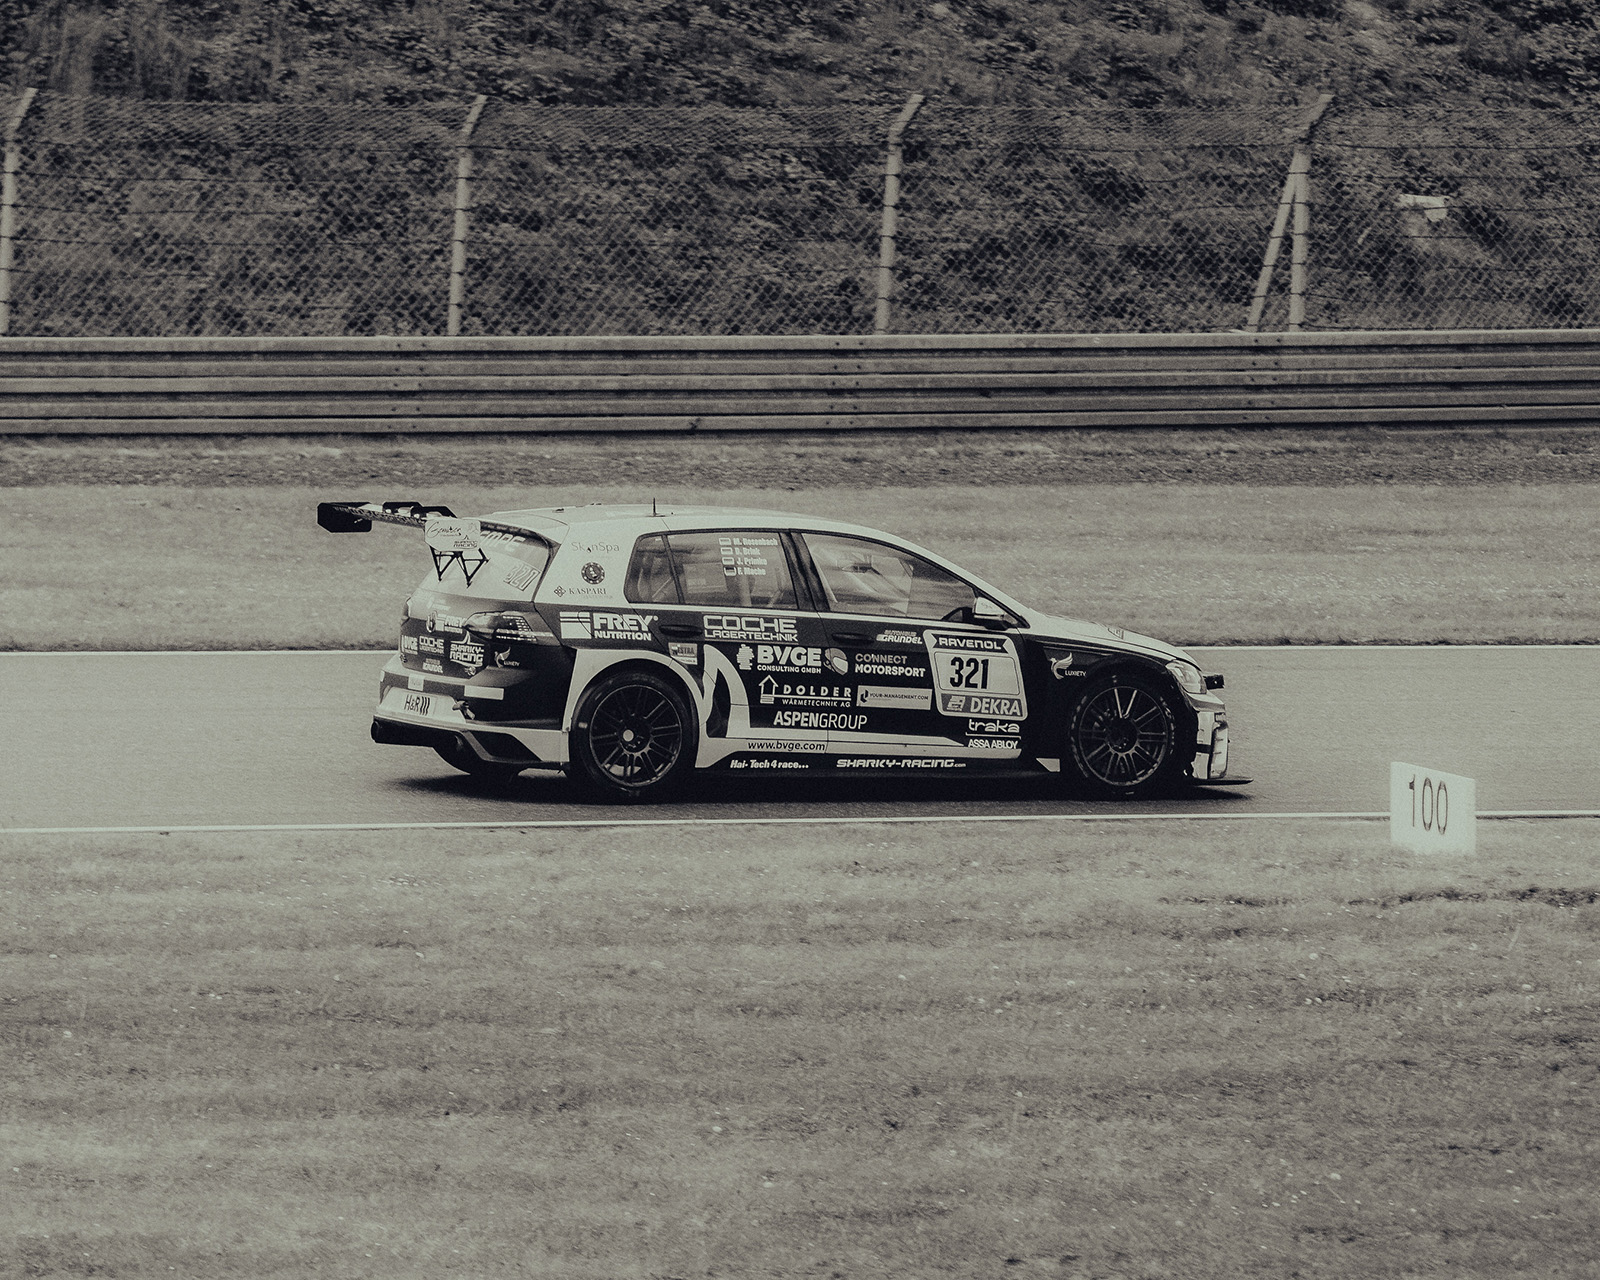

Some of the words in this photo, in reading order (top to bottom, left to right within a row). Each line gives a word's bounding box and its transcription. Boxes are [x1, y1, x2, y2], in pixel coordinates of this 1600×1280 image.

[571, 541, 620, 553] SknSpa
[593, 612, 653, 632] FREY
[703, 615, 797, 633] COCHE
[419, 635, 444, 649] COCHE
[594, 630, 652, 641] NUTRITION
[704, 629, 798, 642] LAGERTECHNIK
[938, 637, 1002, 650] RAVENOL
[449, 651, 483, 664] RACING
[757, 645, 822, 667] BVGE
[855, 653, 907, 664] CONNECT
[757, 664, 799, 673] CONSULTING
[855, 663, 926, 677] MOTORSPORT
[949, 656, 989, 689] 321
[783, 684, 852, 697] DOLDER
[970, 697, 1021, 716] DEKRA
[773, 711, 868, 730] ASPENGROUP
[968, 719, 1020, 733] traka
[748, 740, 826, 751] www.bvge.com
[967, 738, 989, 748] ASSA
[991, 740, 1019, 750] ABLOY
[1408, 773, 1448, 835] 100
